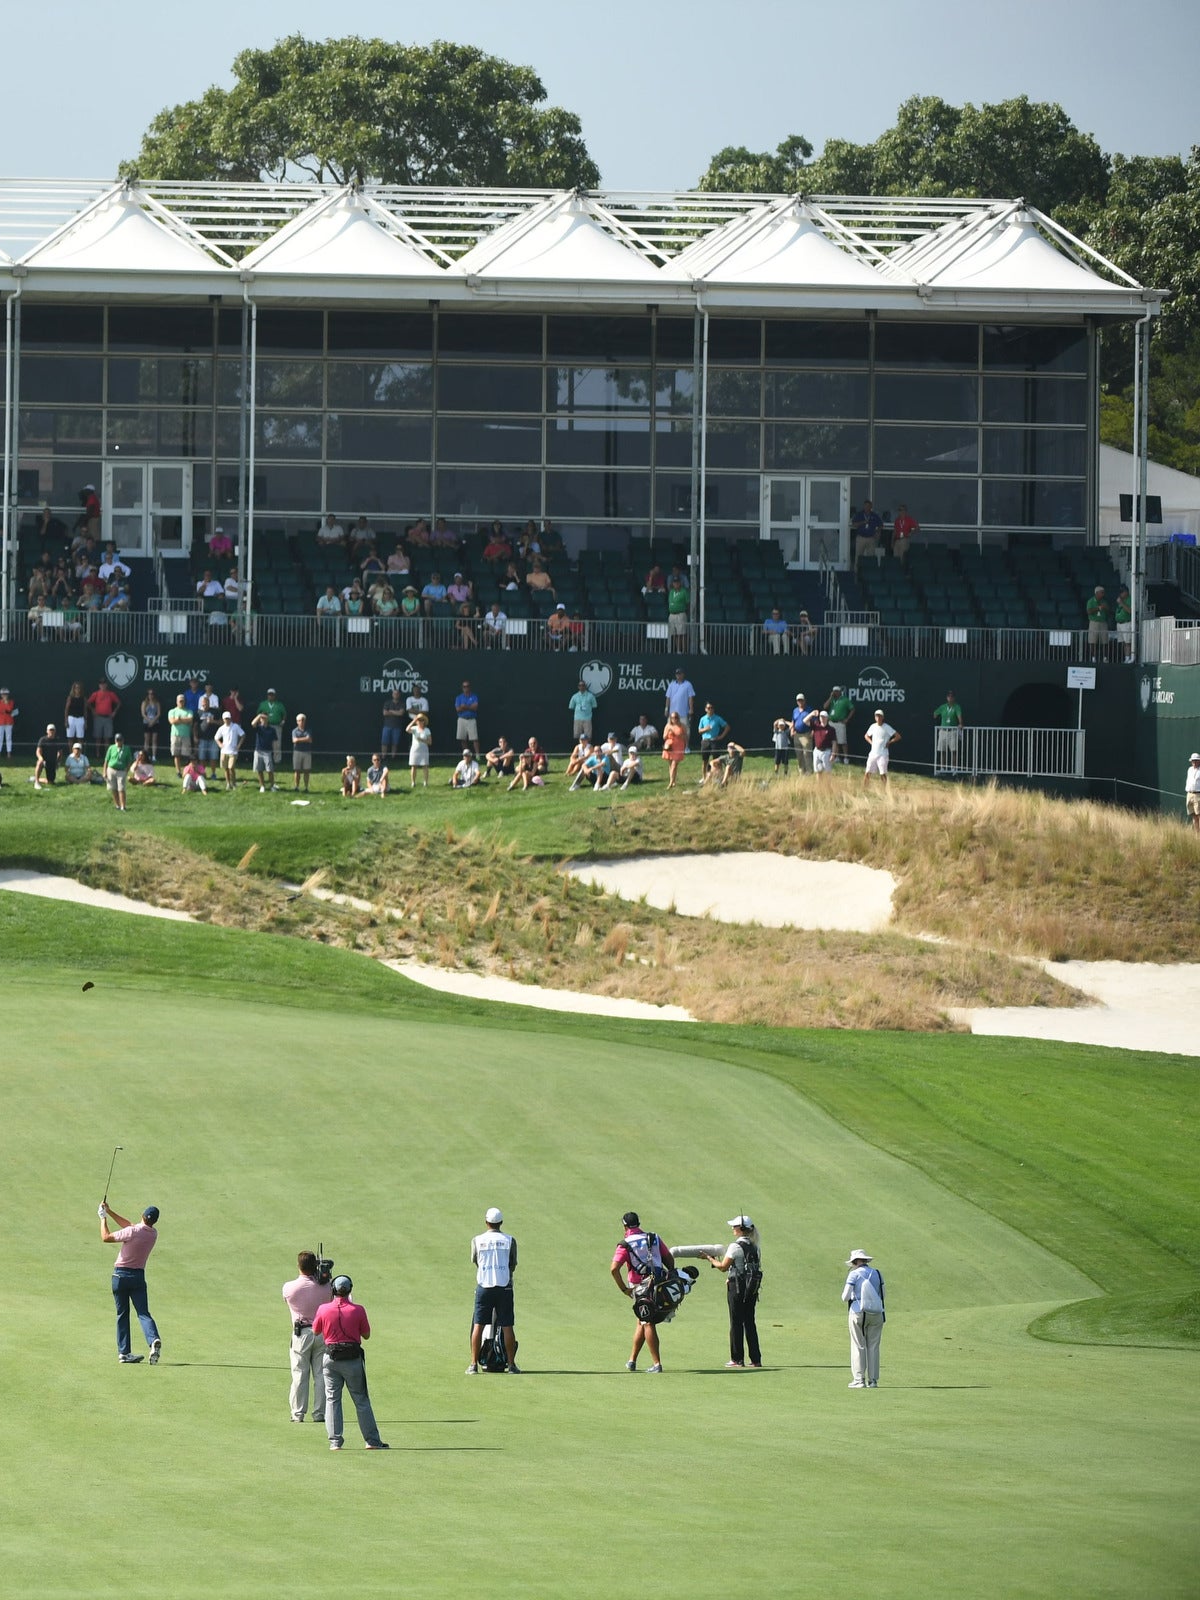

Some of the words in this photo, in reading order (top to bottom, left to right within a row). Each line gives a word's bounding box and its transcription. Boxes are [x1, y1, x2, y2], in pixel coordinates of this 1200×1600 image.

[143, 655, 168, 667] THE
[143, 669, 207, 682] BARCLAYS
[618, 663, 643, 676] THE
[618, 677, 674, 691] BARCLAY
[848, 688, 905, 702] PLAYOFFS
